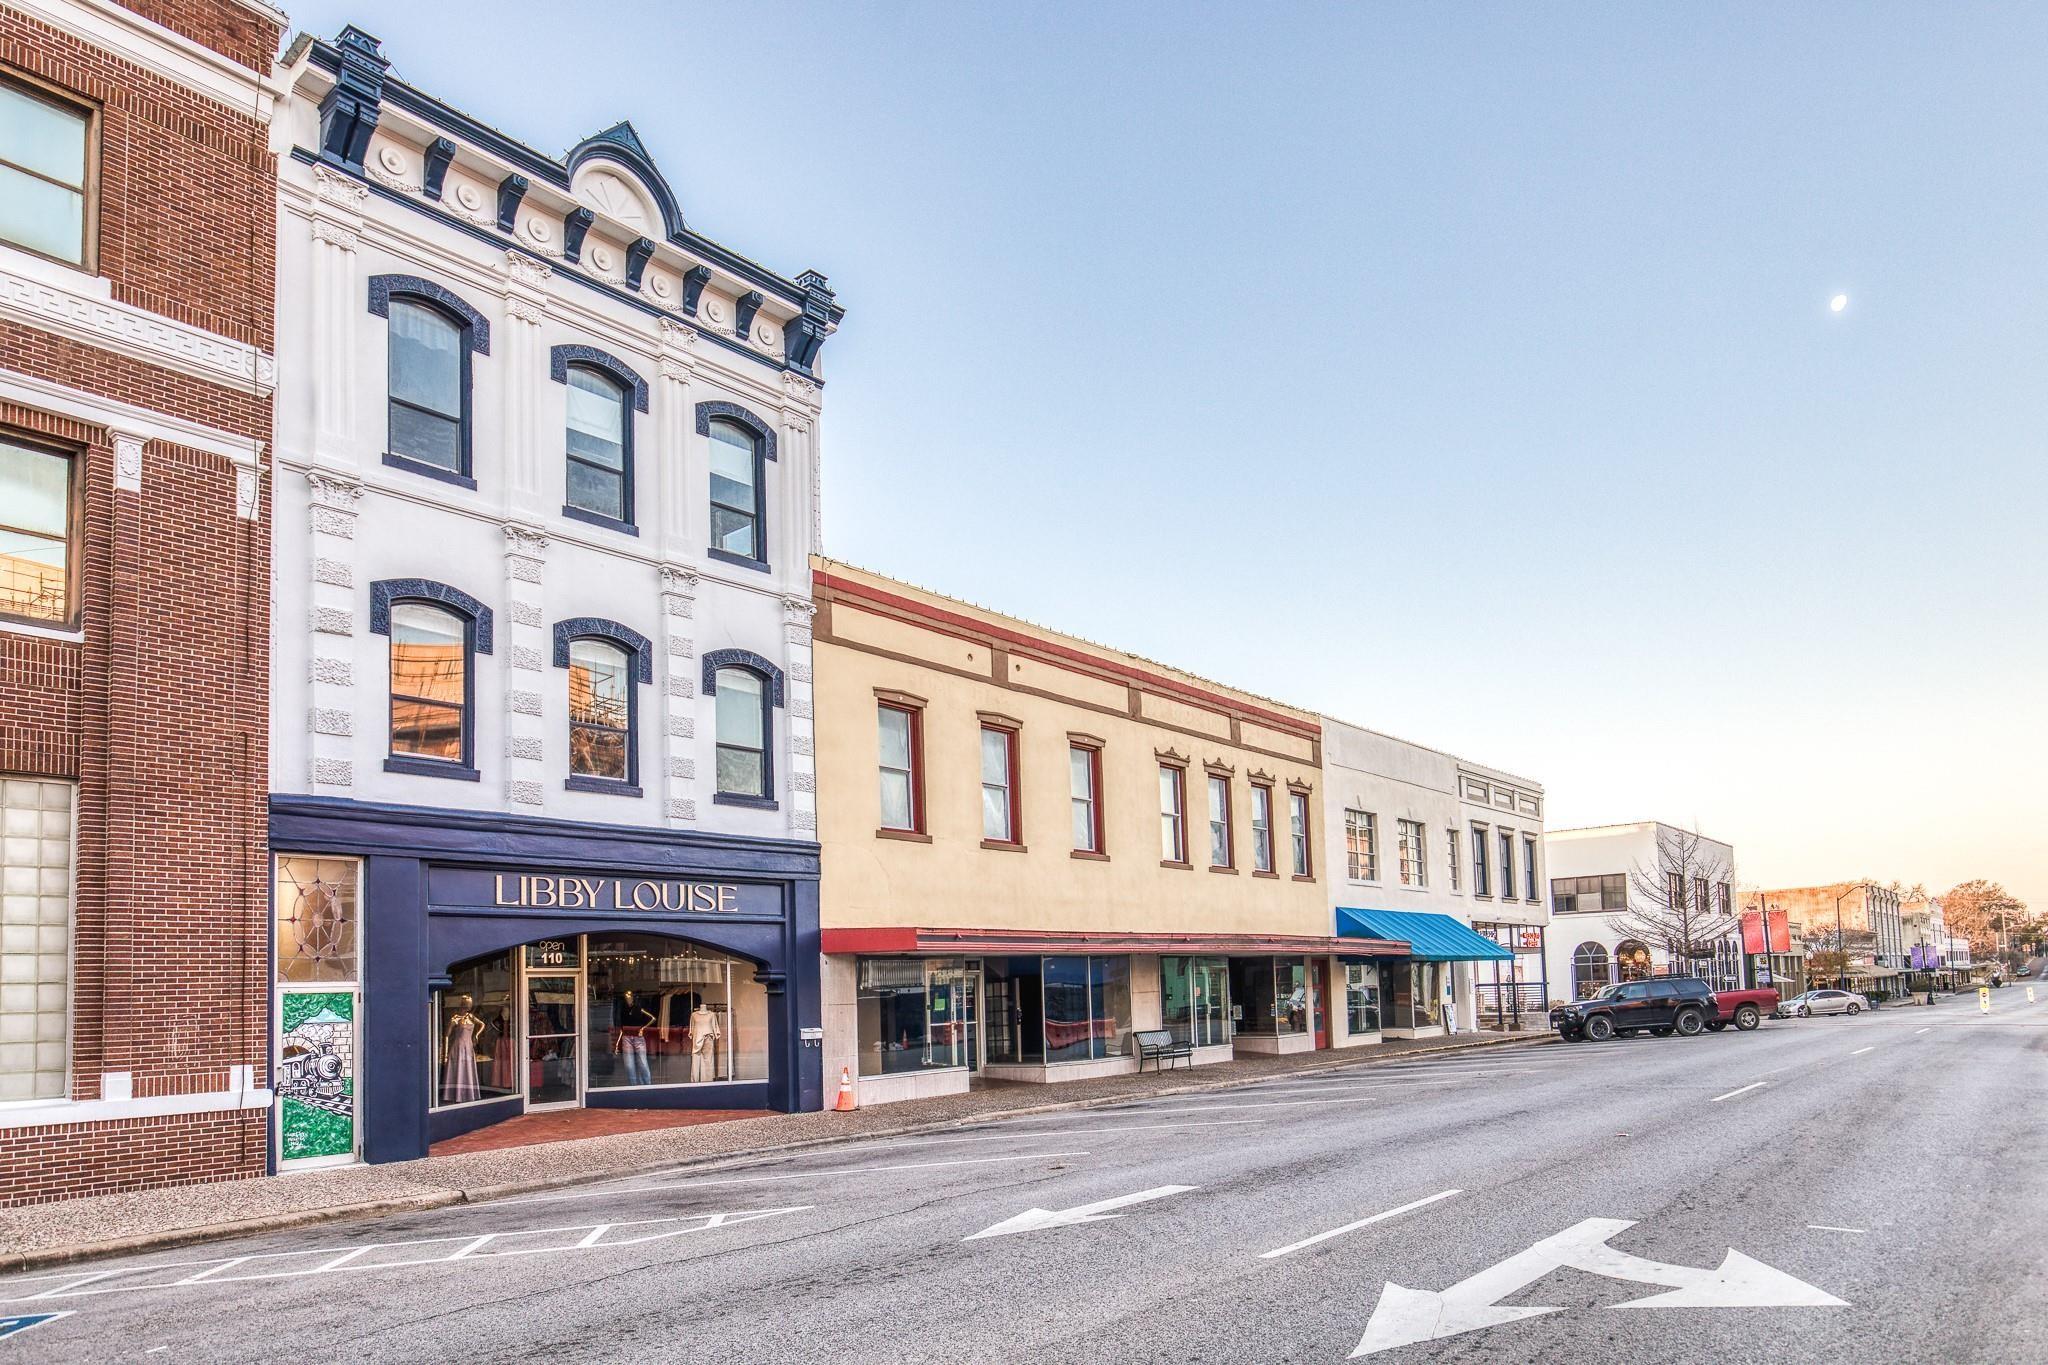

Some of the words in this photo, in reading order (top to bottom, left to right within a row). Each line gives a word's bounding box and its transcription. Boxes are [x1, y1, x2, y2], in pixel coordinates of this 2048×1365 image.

[495, 874, 605, 908] LIBBY
[614, 880, 738, 912] LOUISE
[541, 952, 563, 964] 110
